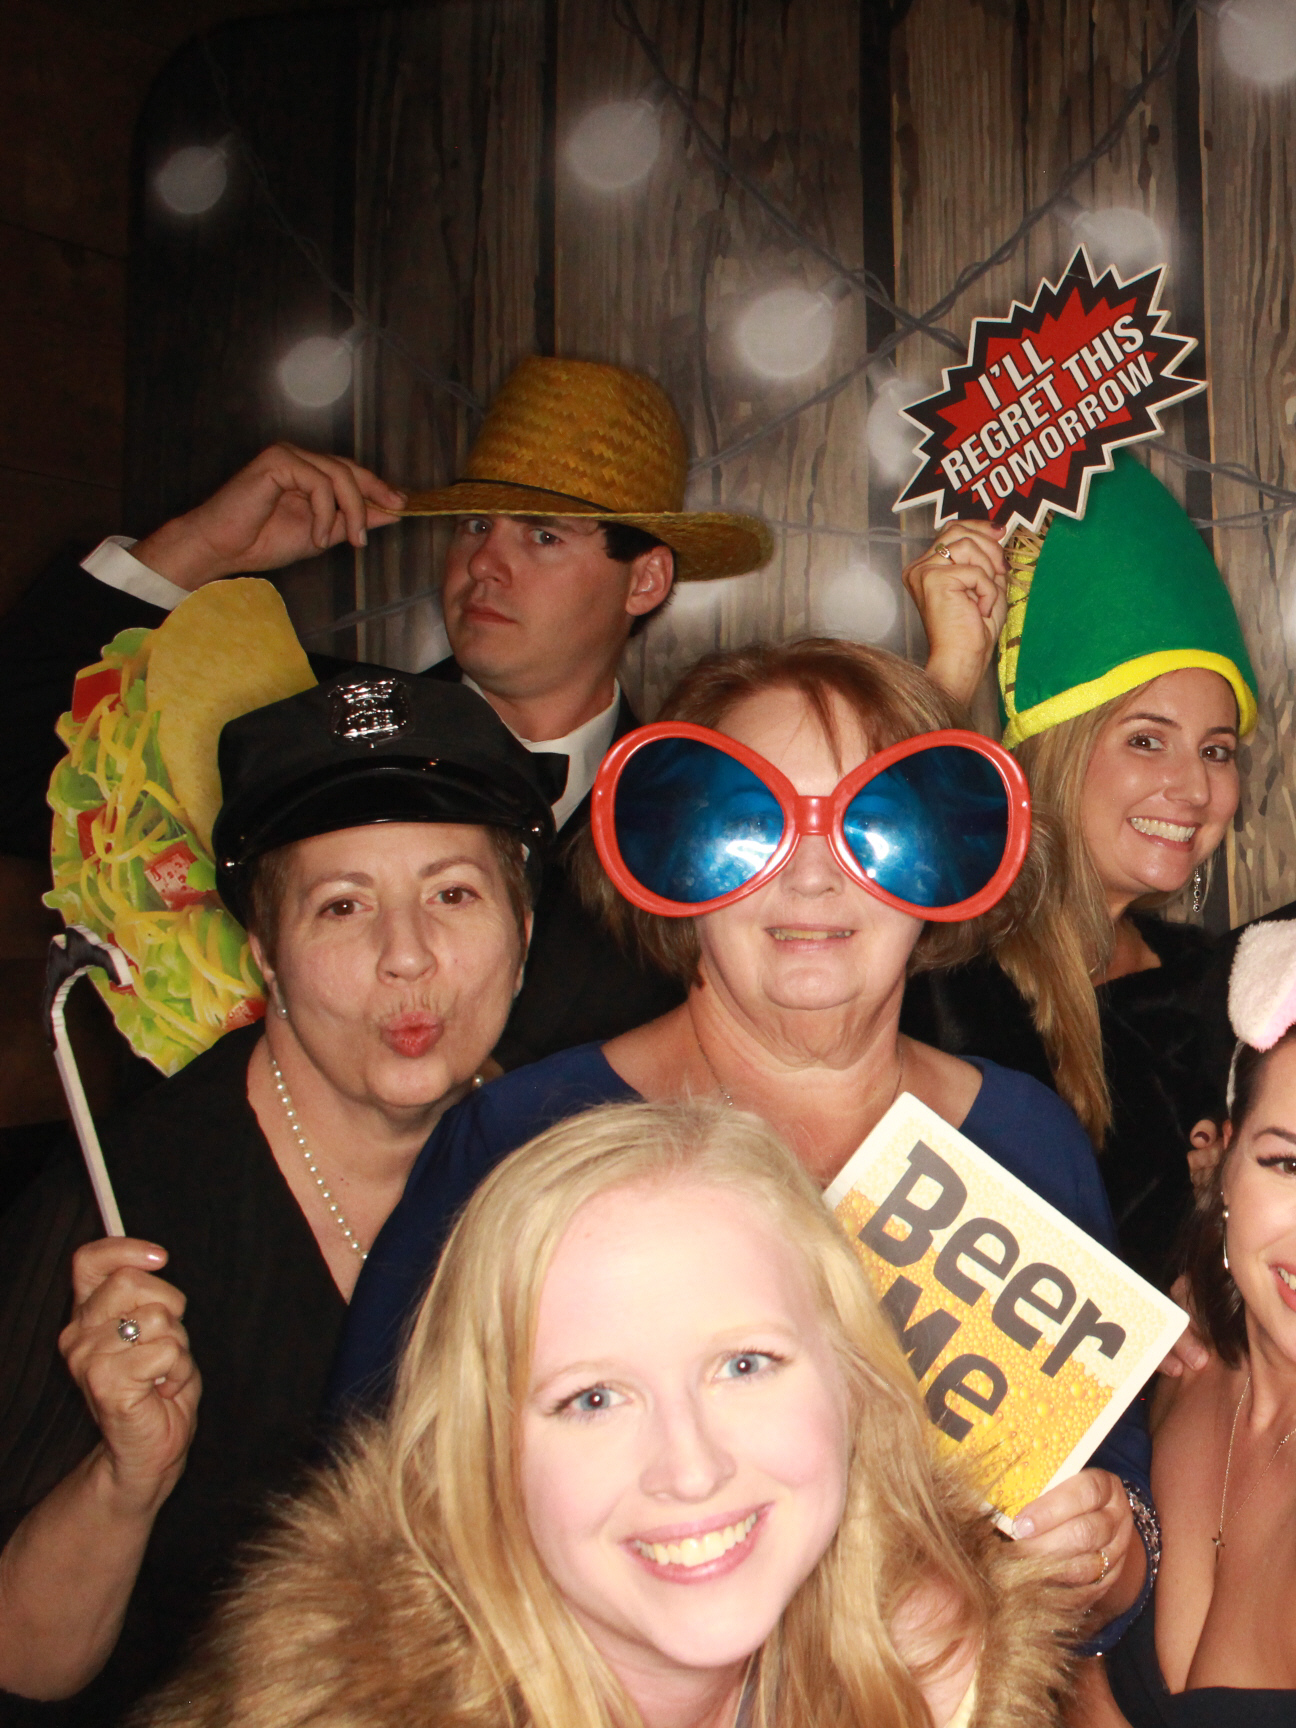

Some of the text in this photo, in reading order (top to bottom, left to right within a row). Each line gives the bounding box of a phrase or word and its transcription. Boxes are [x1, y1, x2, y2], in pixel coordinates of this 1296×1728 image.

[940, 315, 1145, 491] REGRET THIS
[970, 353, 1154, 511] TOMORROW
[978, 338, 1054, 410] I'LL
[857, 1139, 1127, 1379] Beer
[881, 1274, 1009, 1443] Me
